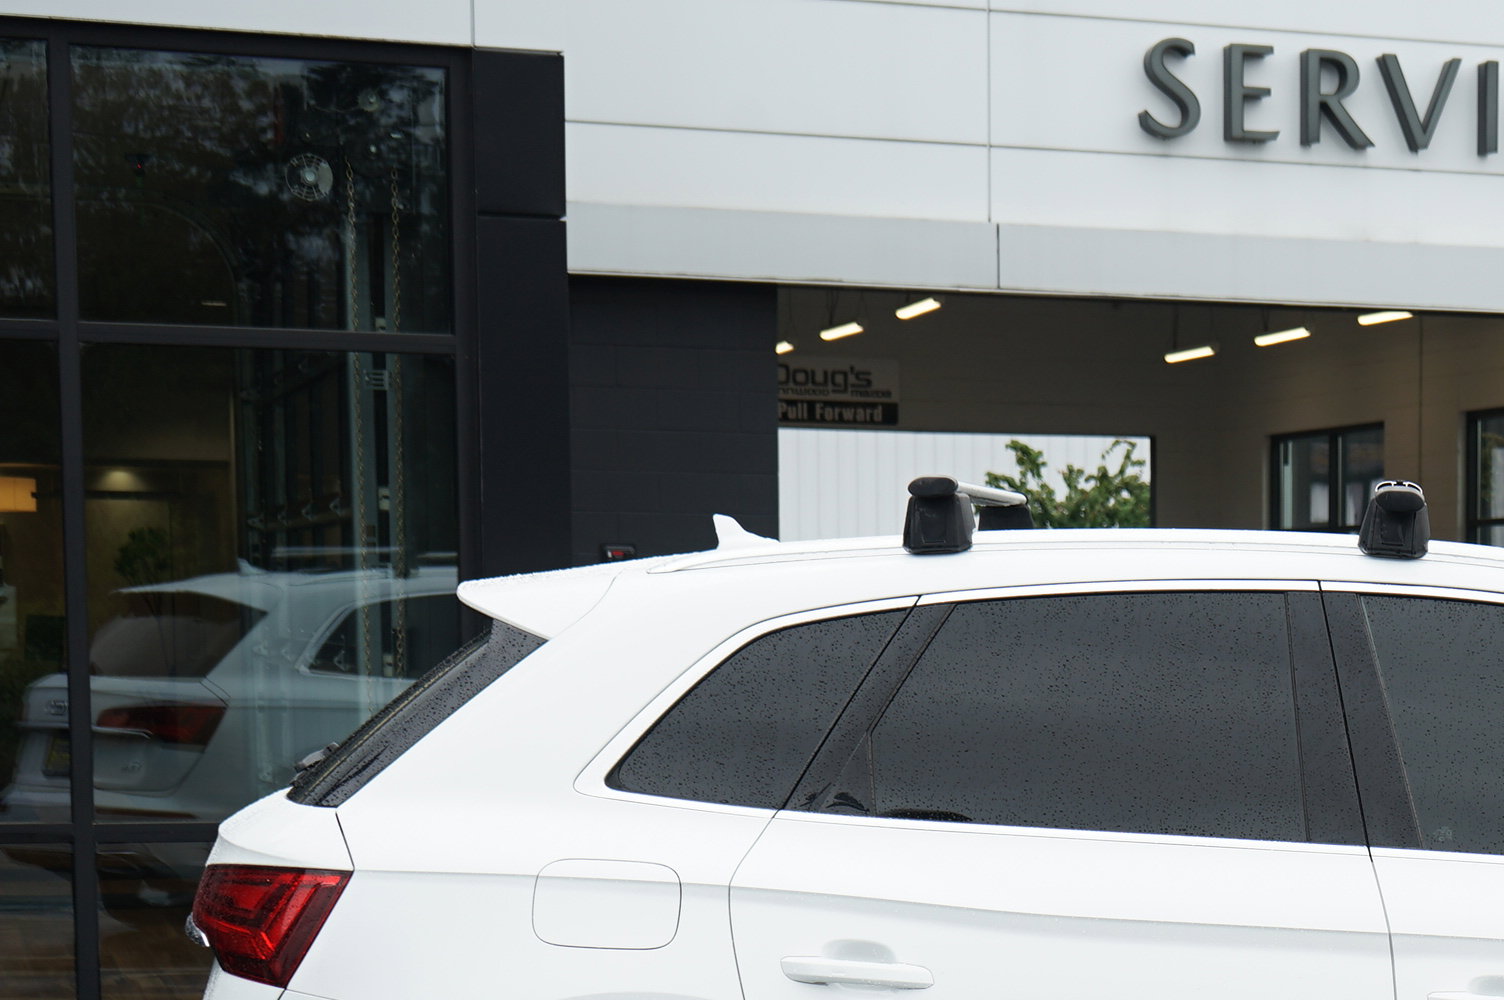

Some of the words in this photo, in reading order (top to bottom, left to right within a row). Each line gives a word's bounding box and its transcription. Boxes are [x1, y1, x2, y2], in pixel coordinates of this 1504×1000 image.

[778, 364, 872, 394] Doug's
[779, 402, 808, 419] Pull
[816, 403, 882, 422] Forward
